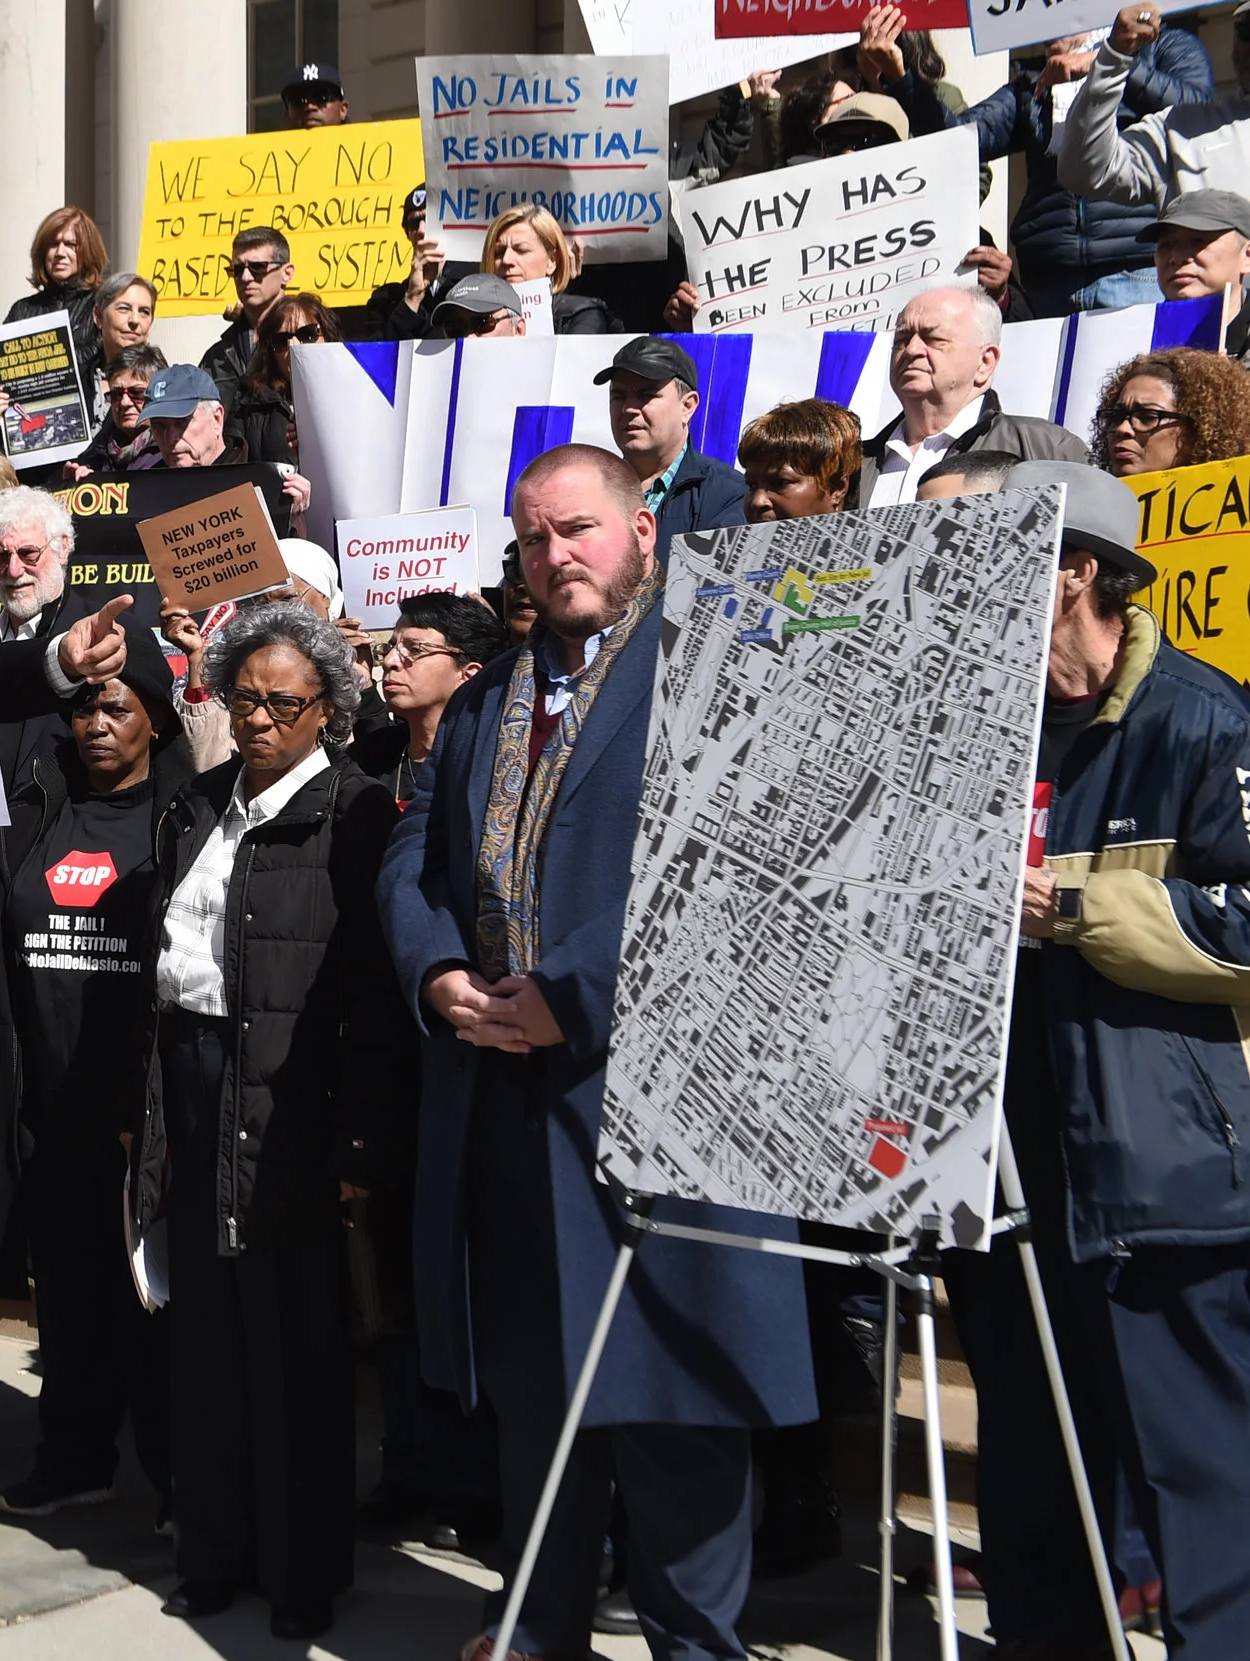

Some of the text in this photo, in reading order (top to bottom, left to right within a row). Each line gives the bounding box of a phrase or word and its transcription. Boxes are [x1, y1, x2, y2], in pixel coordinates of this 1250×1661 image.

[303, 63, 319, 80] NY
[432, 71, 638, 113] NO JAILS IN
[443, 127, 659, 163] RESIDENTIAL
[160, 141, 392, 204] WE SAY NO
[155, 217, 185, 238] TO
[199, 208, 255, 235] THE
[692, 166, 927, 246] WHY HAS
[151, 240, 413, 297] BASED SYSTEM
[698, 220, 936, 298] THE PRESS
[709, 258, 941, 328] BEEN EXCLUDED
[809, 298, 880, 327] FROM
[161, 506, 244, 546] NEW YORK
[1138, 475, 1250, 544] TICA
[171, 527, 245, 562] Taxpayers
[172, 540, 258, 580] Screwed for
[346, 531, 471, 558] Community
[70, 564, 99, 585] BE
[105, 563, 156, 584] BUIL
[184, 559, 260, 595] $20 billion
[372, 557, 447, 580] is NOT
[214, 604, 228, 620] NO
[1149, 566, 1229, 641] IRE
[53, 865, 111, 886] STOP
[49, 914, 70, 931] THE
[74, 915, 97, 931] JAIL
[24, 933, 127, 952] SIGN THE PETITION
